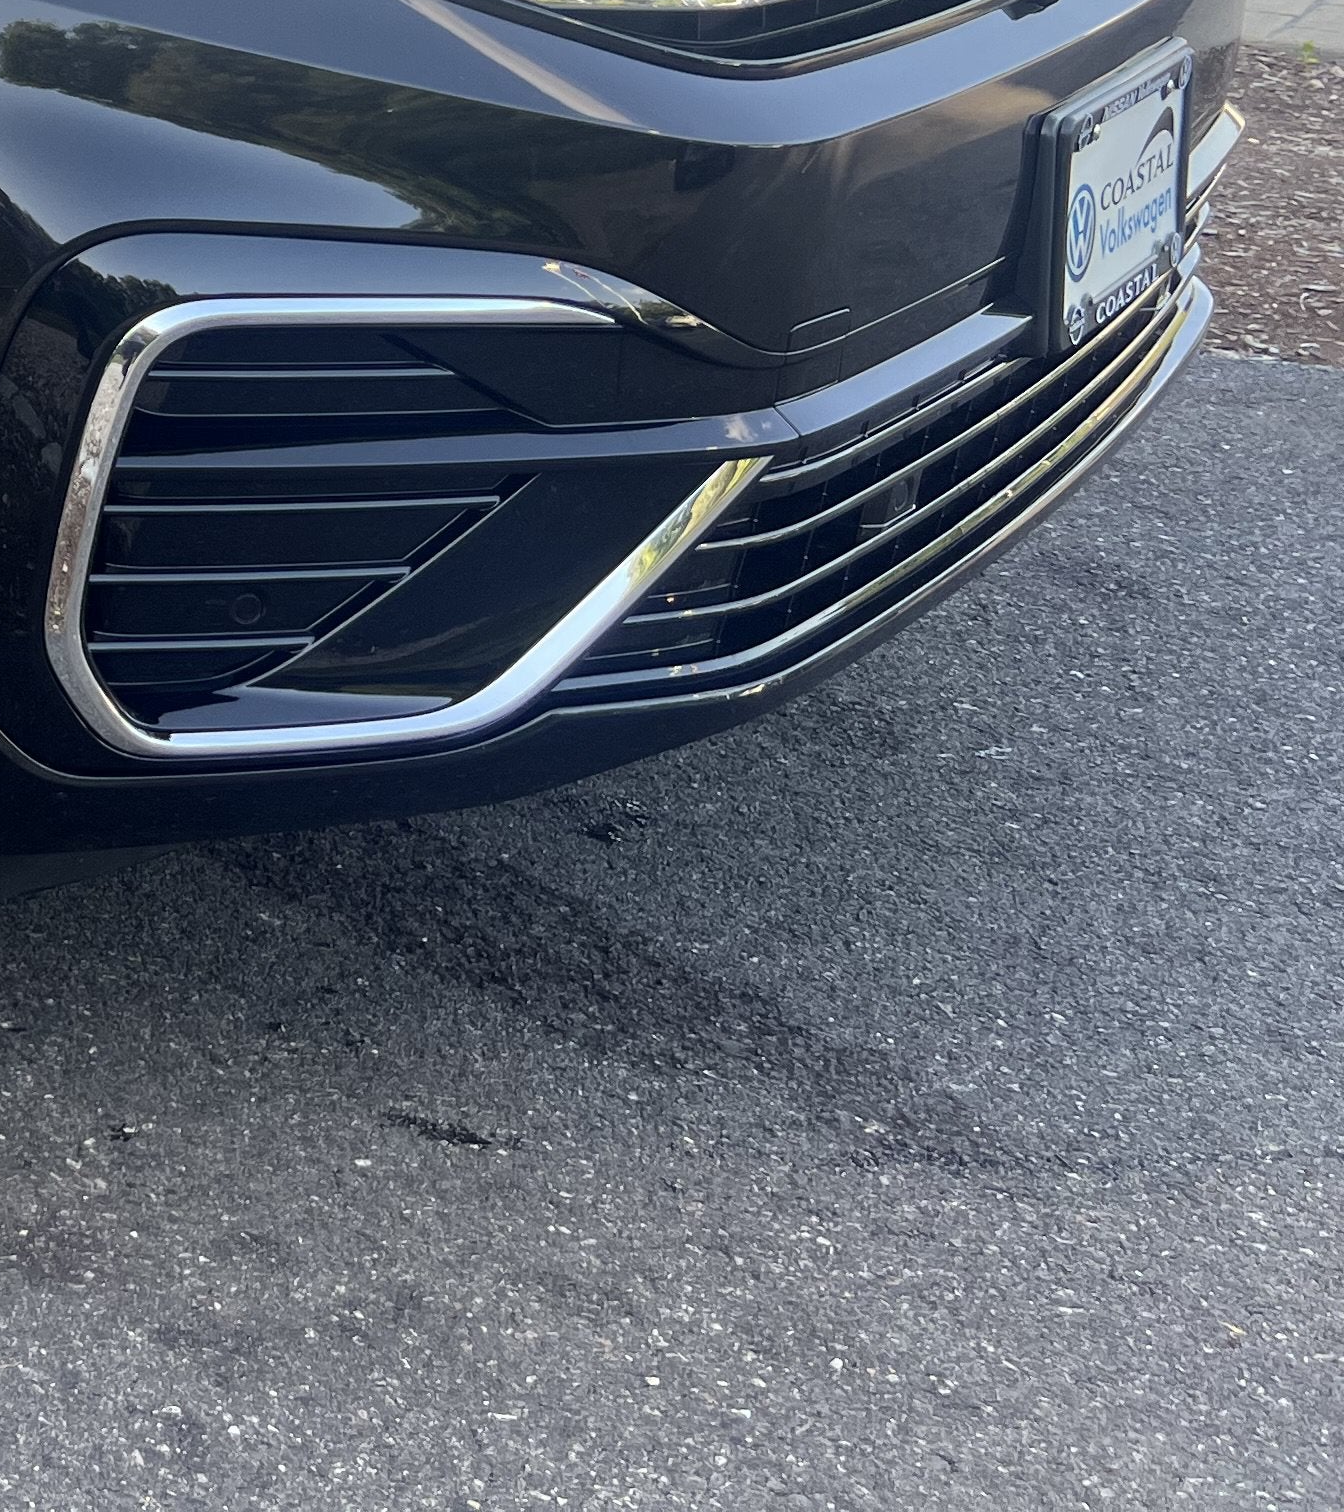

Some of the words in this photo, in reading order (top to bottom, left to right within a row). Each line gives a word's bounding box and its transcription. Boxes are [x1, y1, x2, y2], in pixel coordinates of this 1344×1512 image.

[1101, 143, 1174, 211] COASTAL
[1099, 186, 1172, 259] Volkswagen
[1096, 263, 1160, 325] COASTAL
